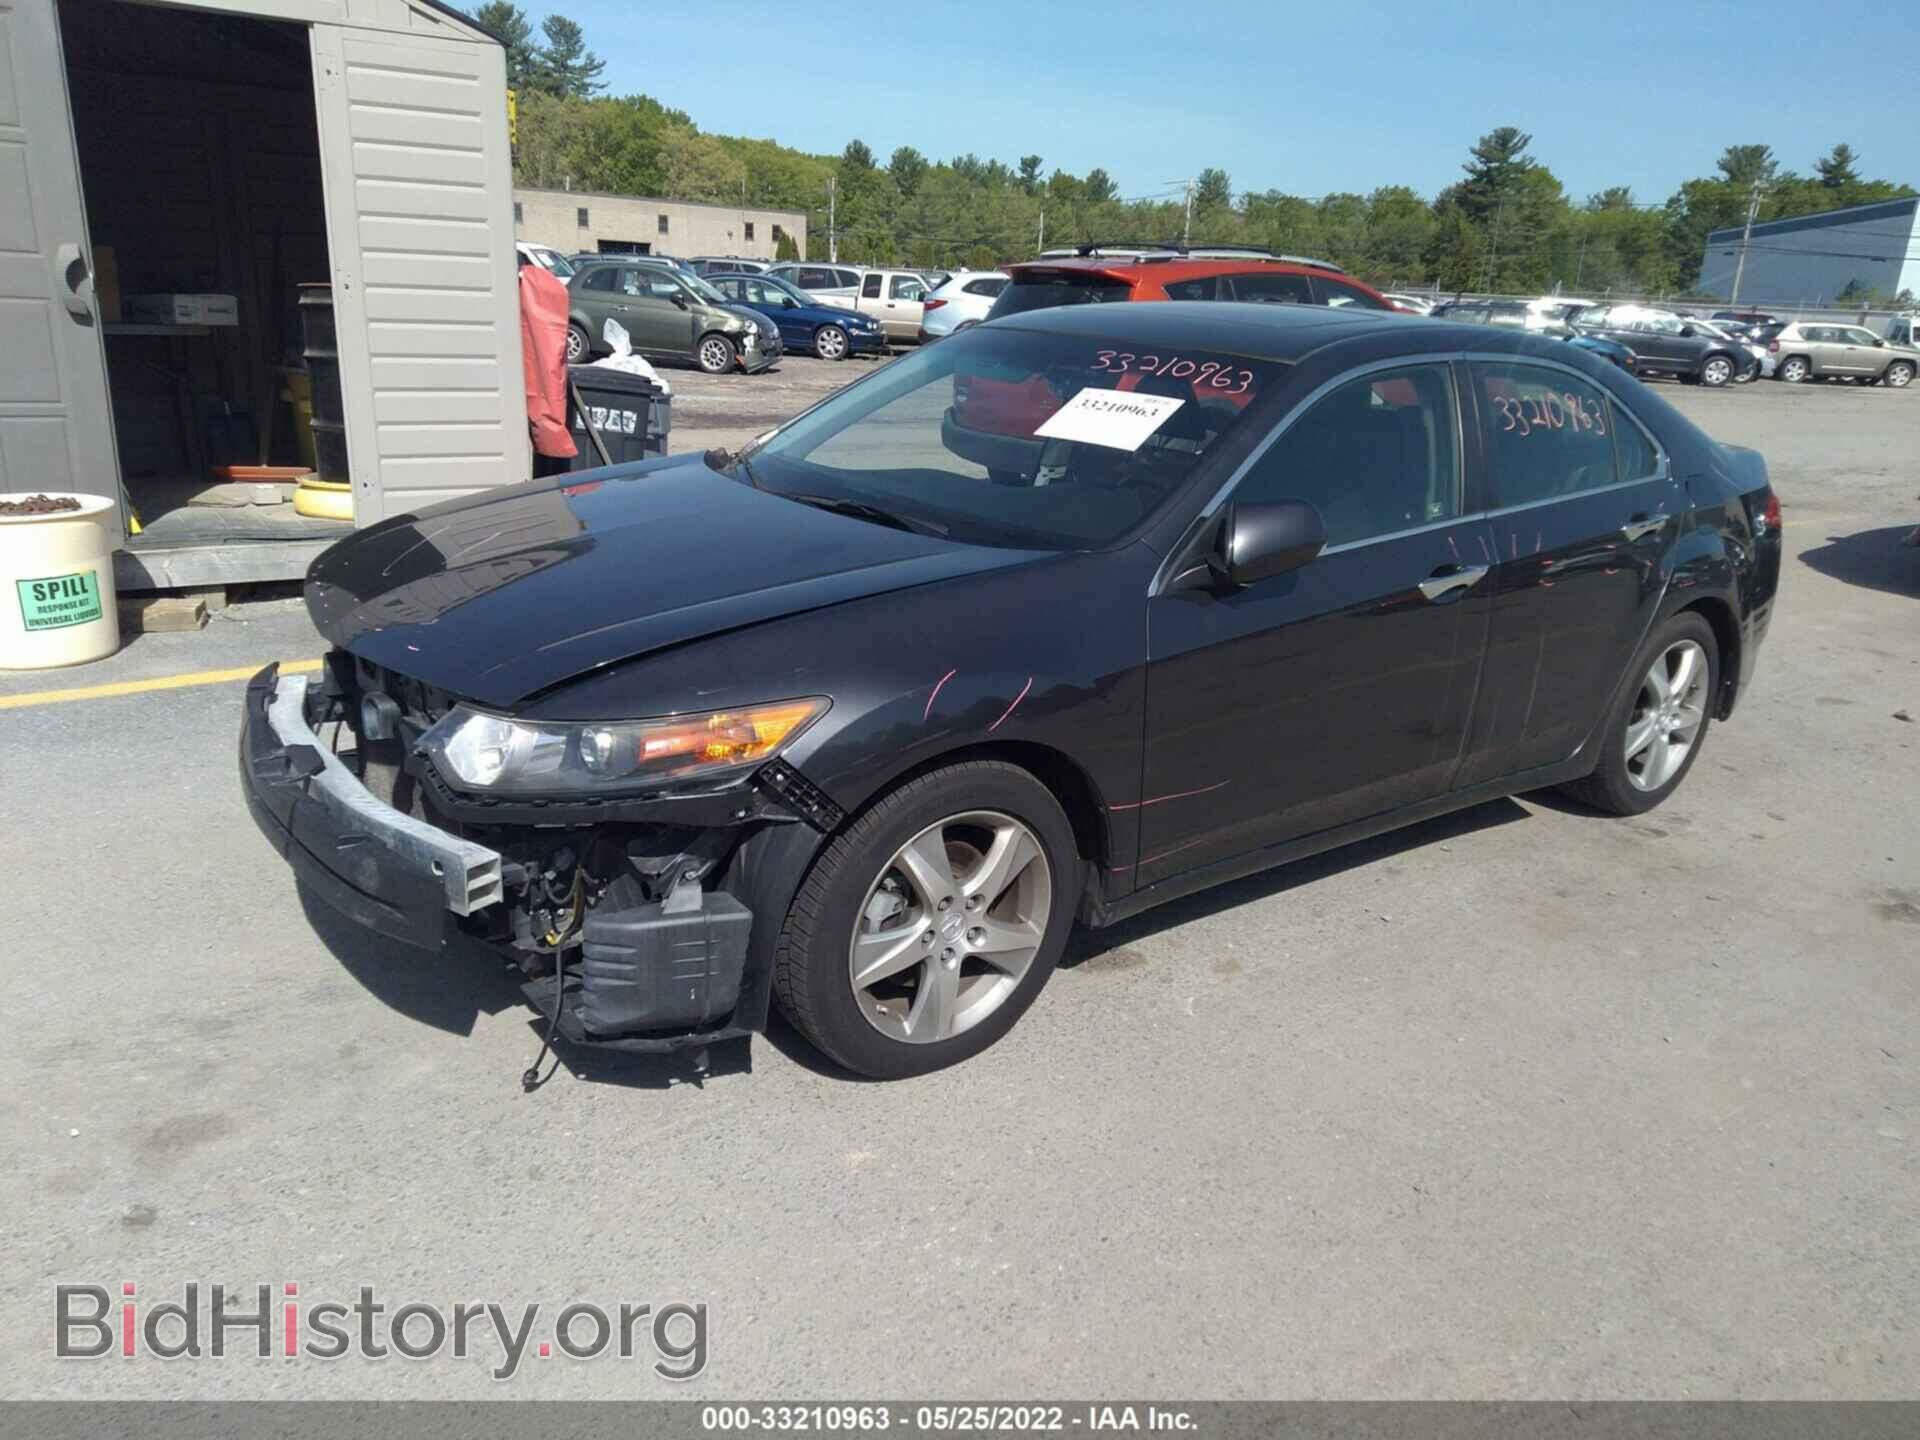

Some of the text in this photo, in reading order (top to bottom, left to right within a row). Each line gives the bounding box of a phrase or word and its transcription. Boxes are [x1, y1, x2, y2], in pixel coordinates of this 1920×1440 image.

[1090, 350, 1253, 394] 33210963
[1075, 399, 1159, 417] 33210963
[1493, 392, 1606, 436] 33210963
[32, 576, 89, 602] SPILL
[37, 601, 78, 614] RESPONSE
[28, 614, 74, 627] UNIVERSAL
